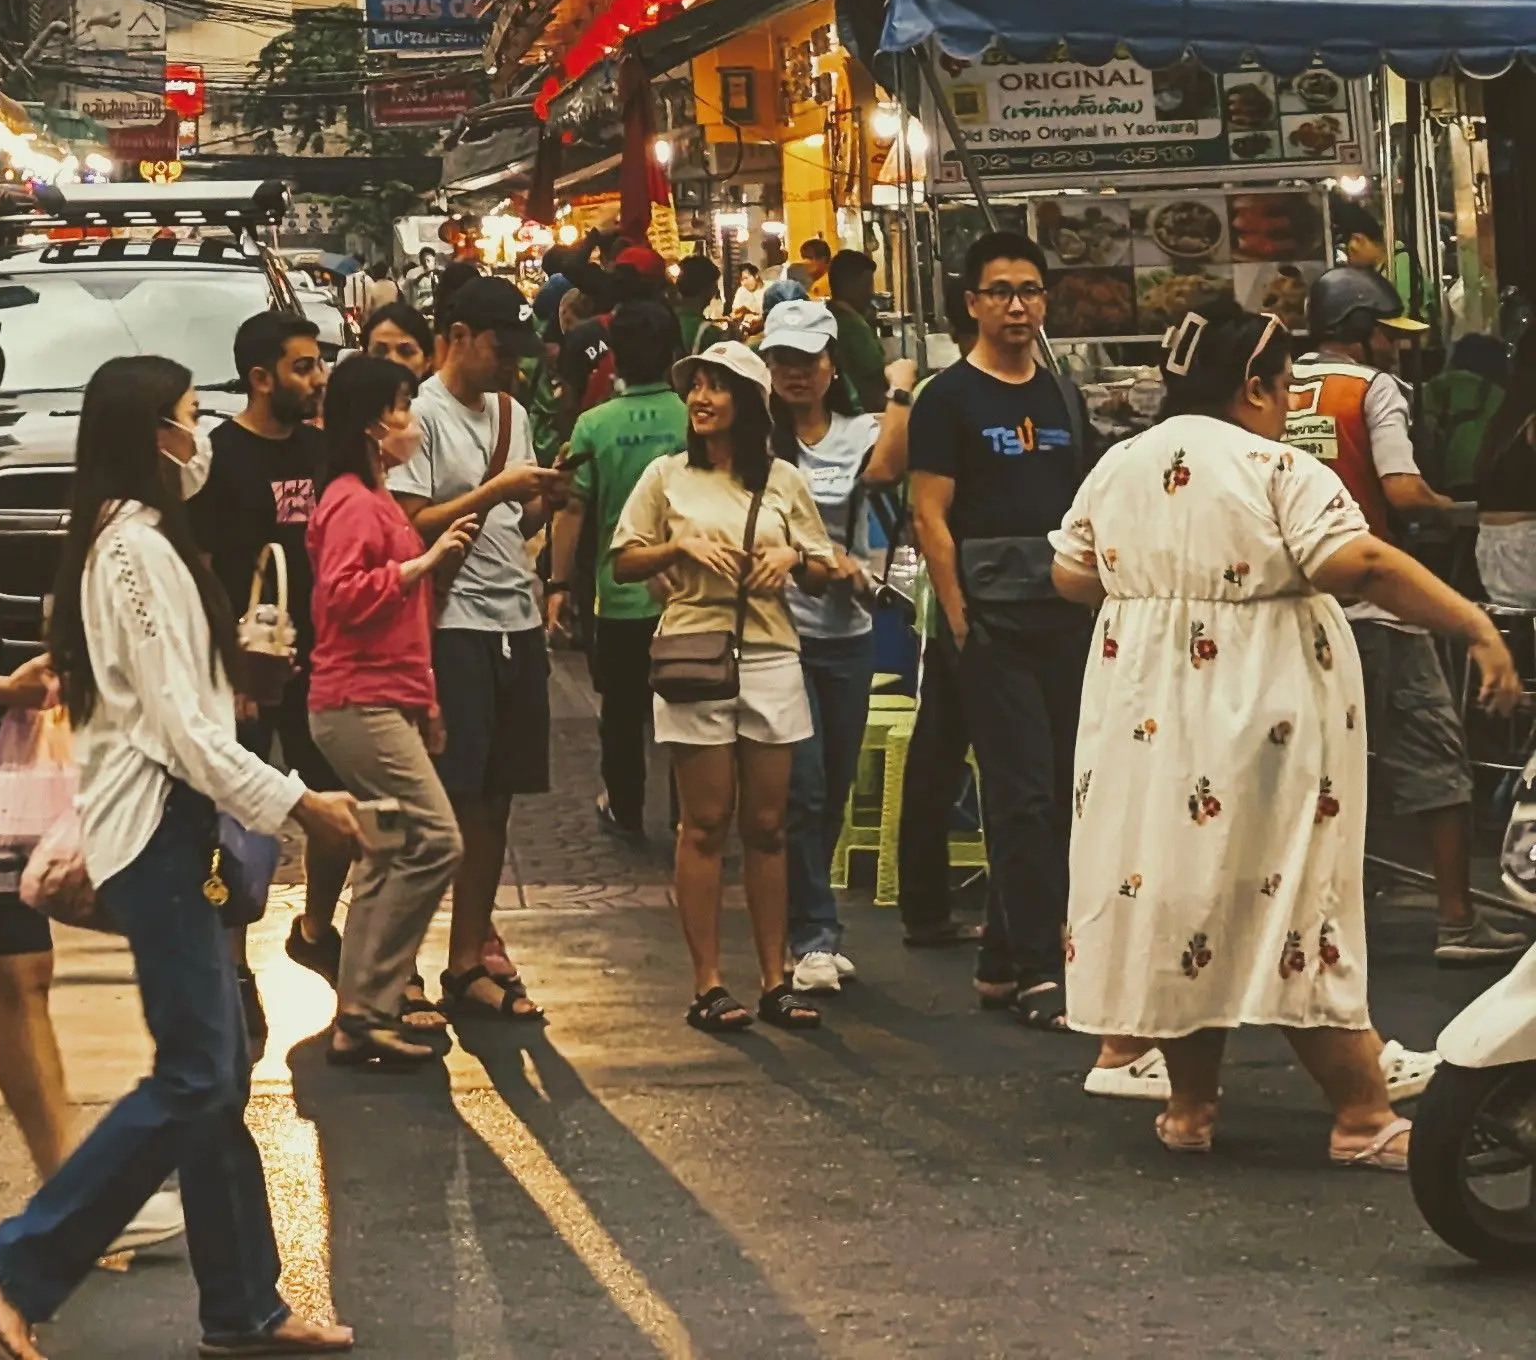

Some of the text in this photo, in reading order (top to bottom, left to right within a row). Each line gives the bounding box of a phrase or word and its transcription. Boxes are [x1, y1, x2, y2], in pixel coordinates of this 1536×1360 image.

[999, 69, 1144, 91] ORIGINAL
[989, 128, 1031, 143] Shop
[1037, 123, 1099, 142] Original
[1123, 119, 1199, 136] Yaowaraj
